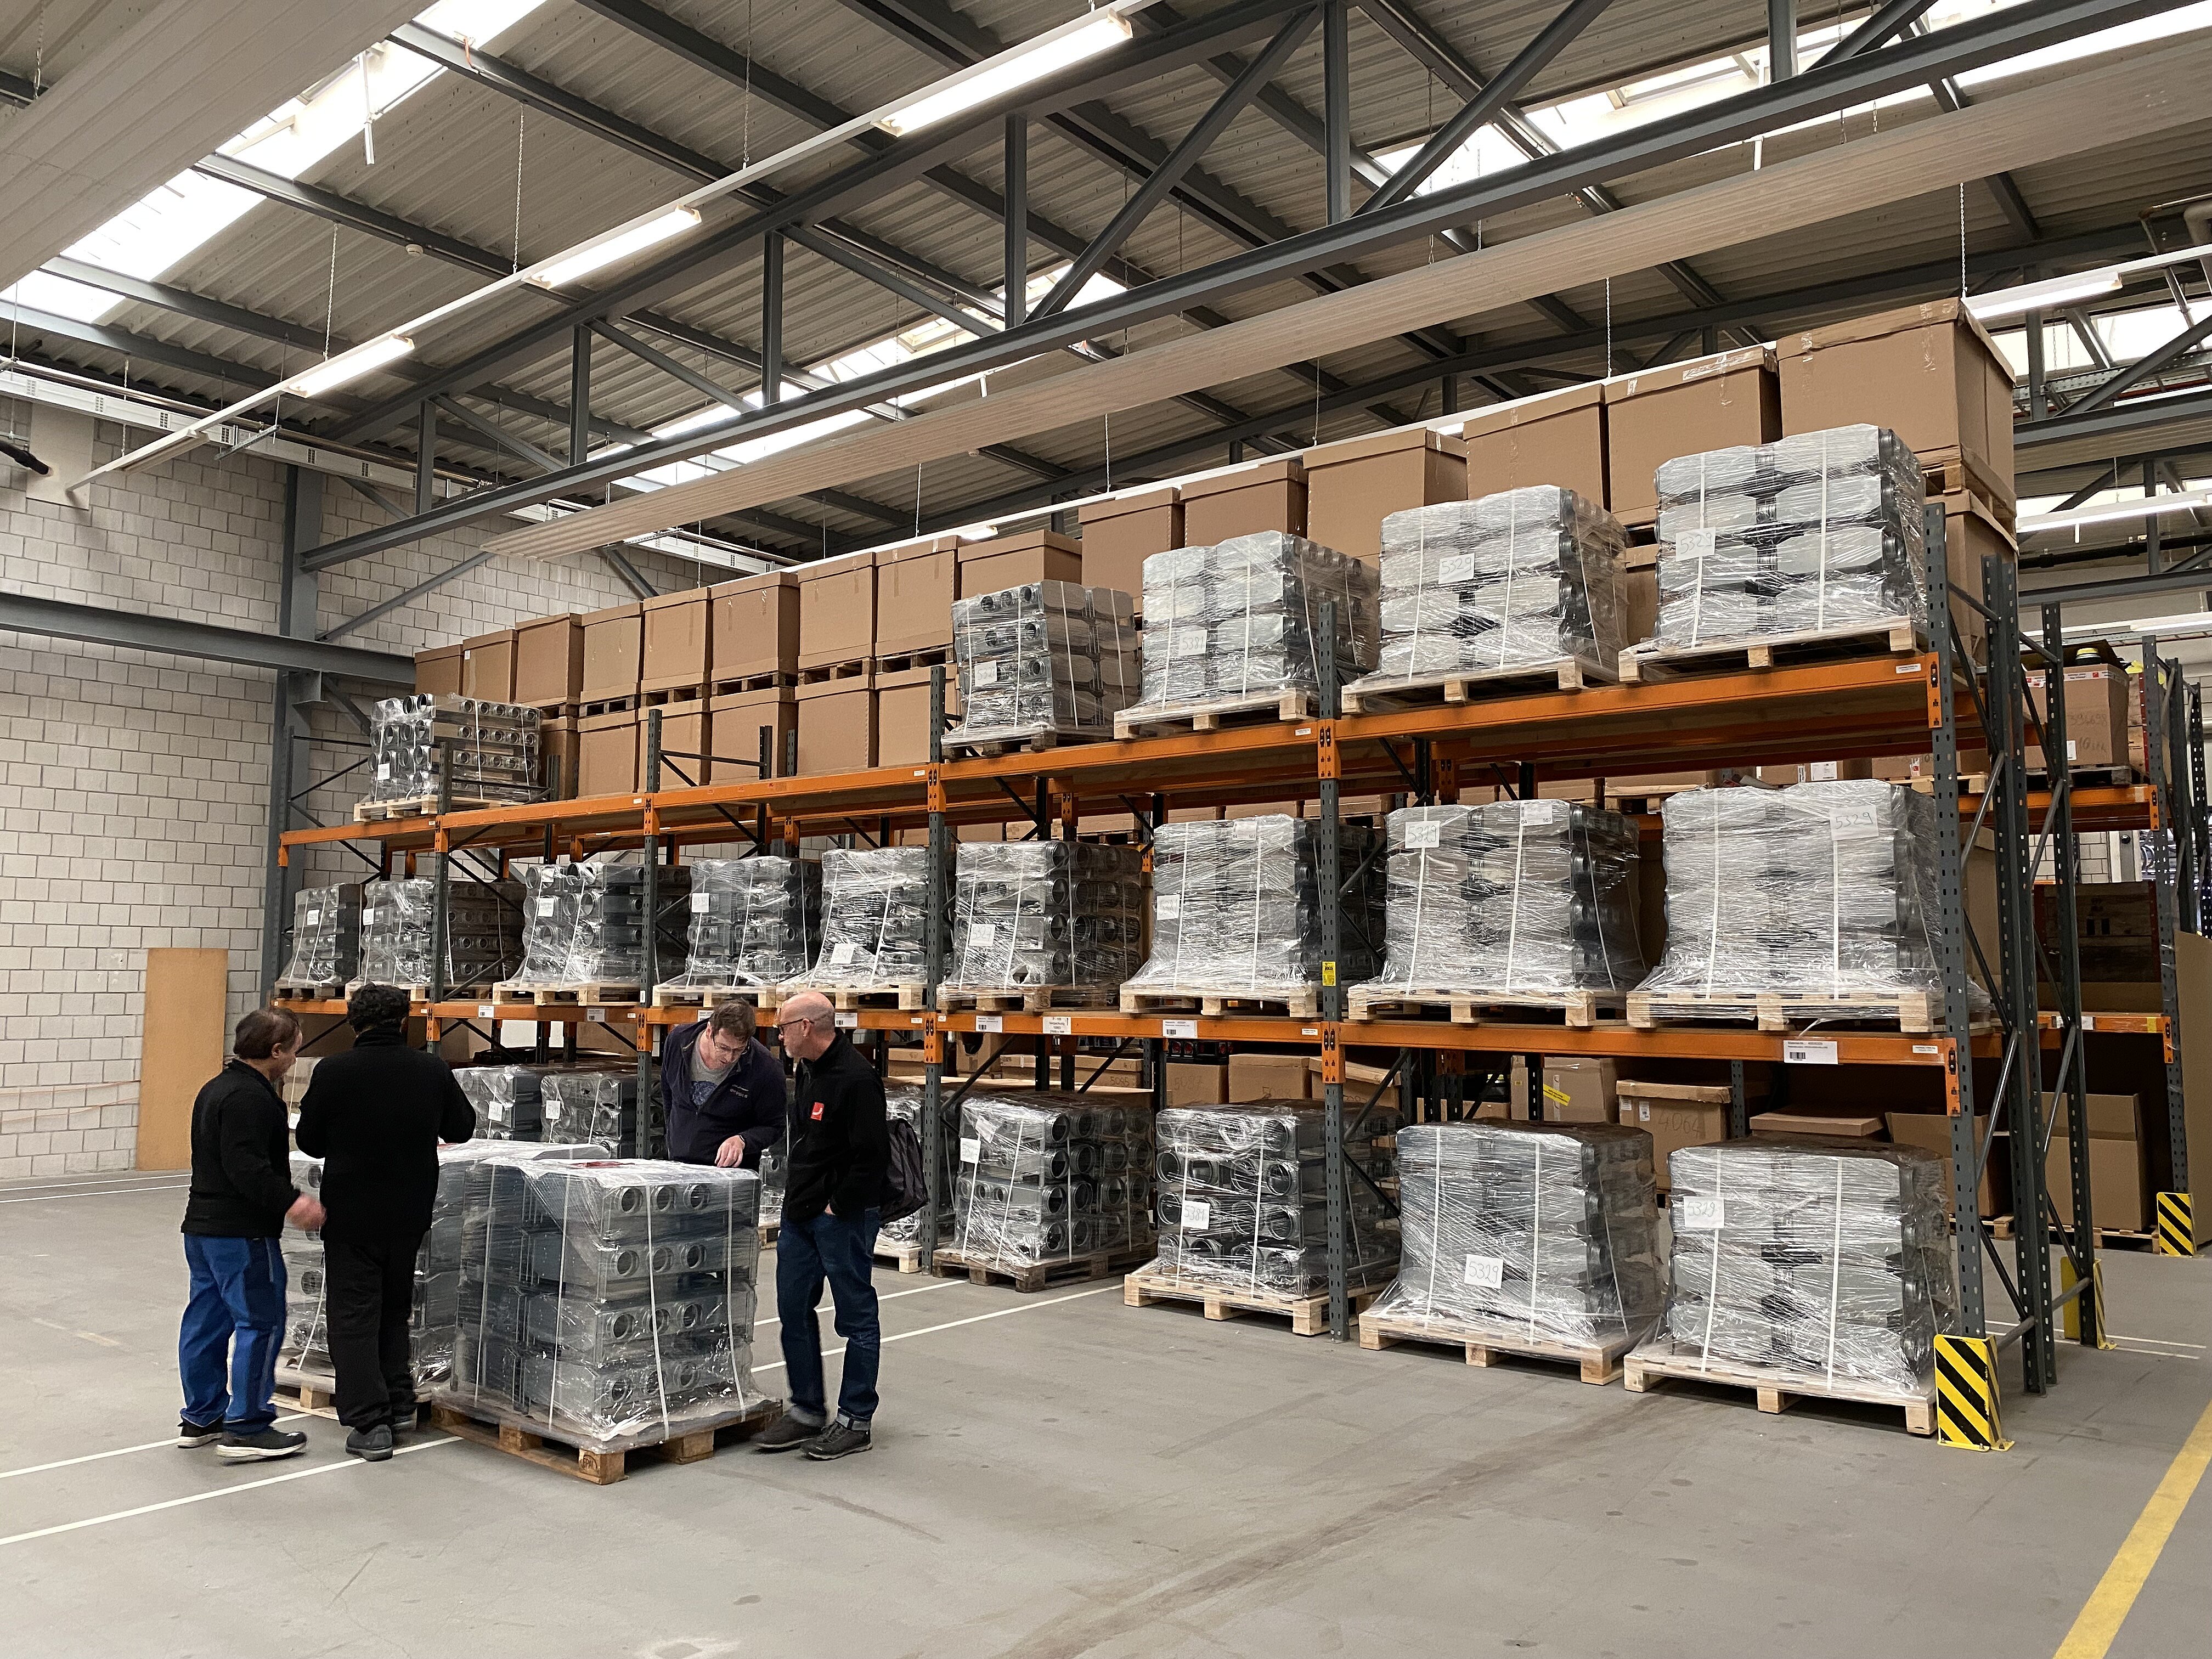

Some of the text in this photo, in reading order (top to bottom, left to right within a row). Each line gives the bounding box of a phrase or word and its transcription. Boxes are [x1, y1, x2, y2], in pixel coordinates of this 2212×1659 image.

[1680, 532, 1712, 554] 5329
[1441, 557, 1472, 575] 5329
[1835, 811, 1874, 830] 5329
[1407, 825, 1437, 843] 5329
[972, 925, 992, 941] 5327
[1658, 1111, 1701, 1139] 4064
[1687, 1201, 1716, 1217] 5329
[1469, 1261, 1499, 1284] 5329
